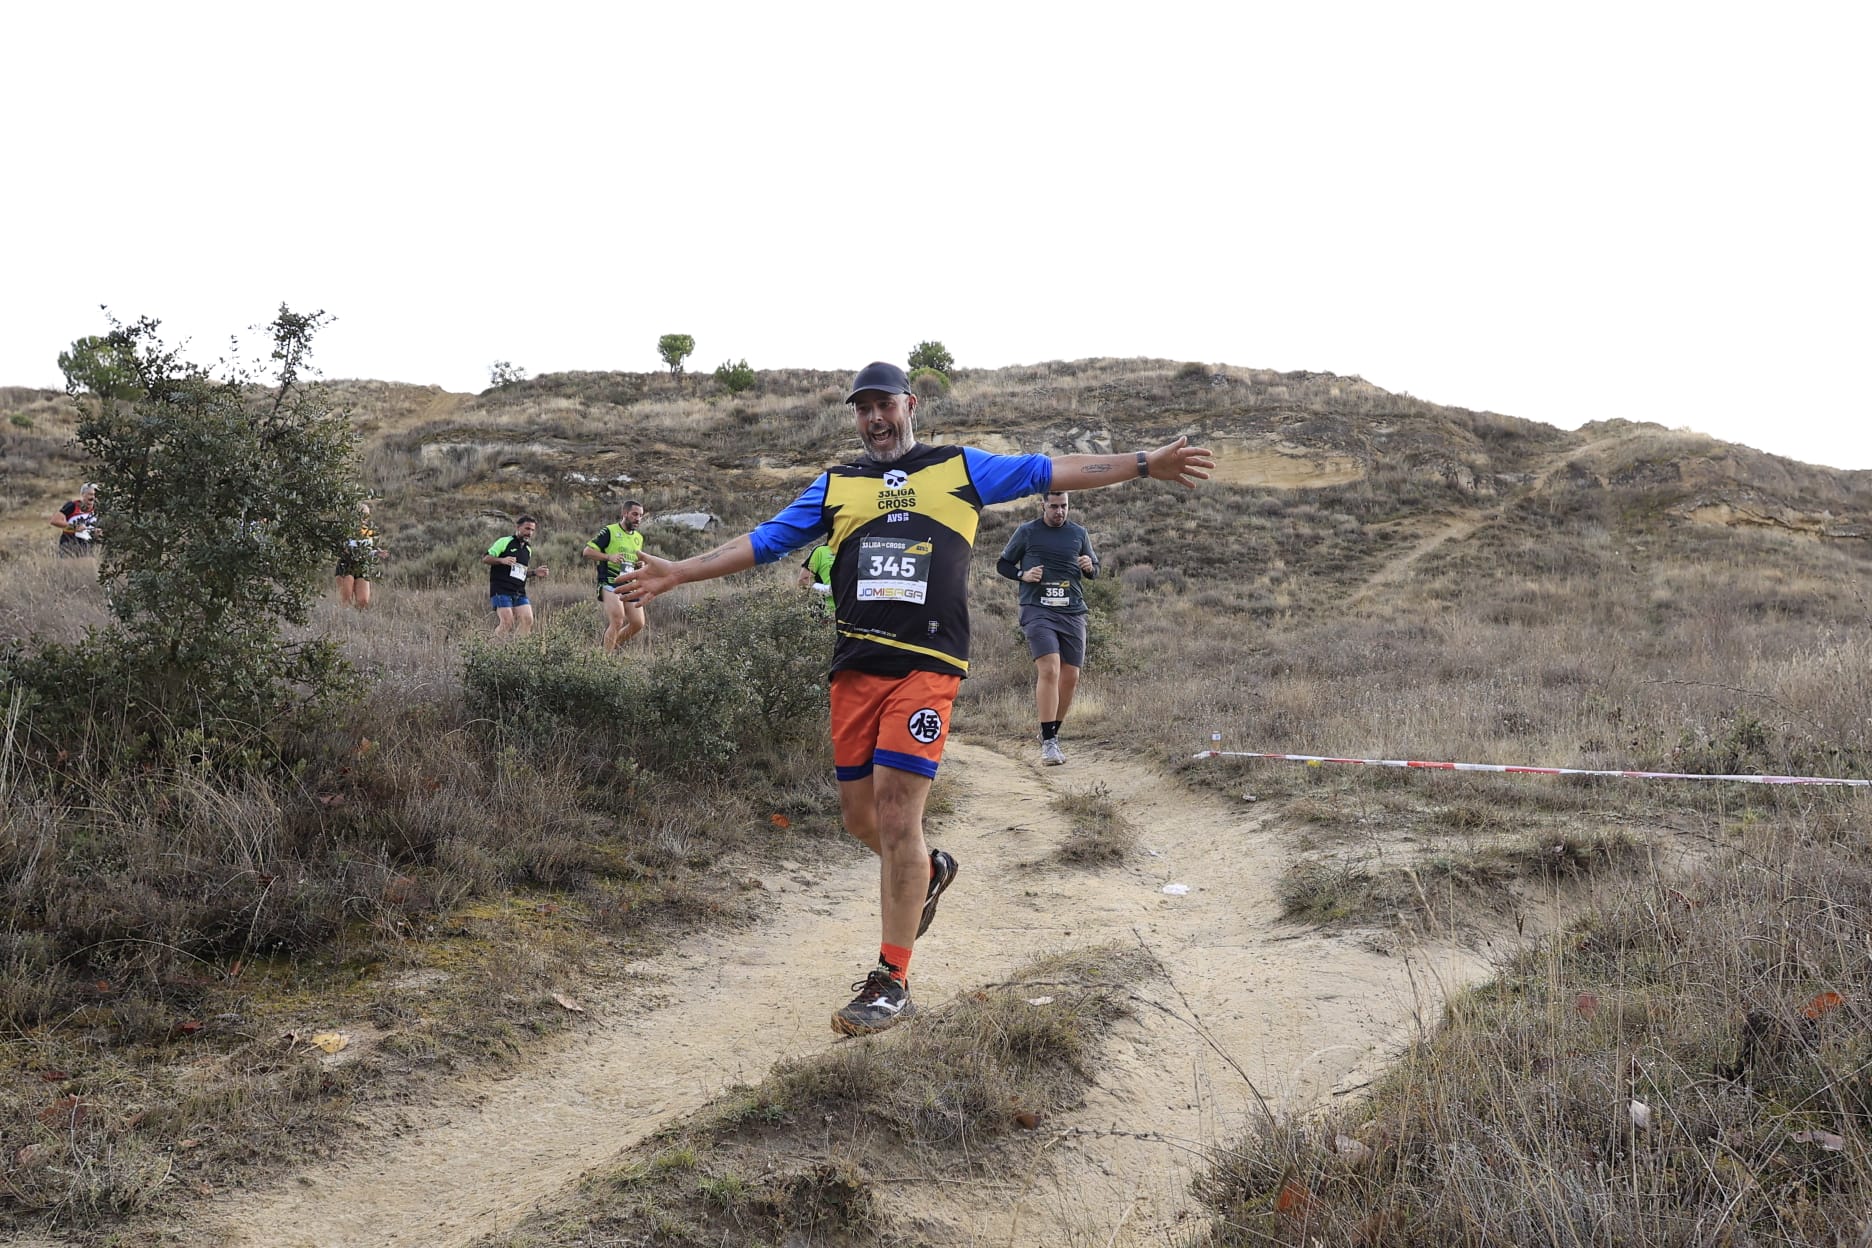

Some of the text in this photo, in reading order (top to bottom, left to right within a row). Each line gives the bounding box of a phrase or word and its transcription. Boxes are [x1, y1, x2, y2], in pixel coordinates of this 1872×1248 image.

[878, 498, 916, 510] CROSS
[887, 514, 902, 523] AVS
[870, 556, 916, 577] 345
[859, 588, 923, 600] JOMISAGA
[1046, 588, 1064, 597] 358
[911, 713, 939, 739] 悟
